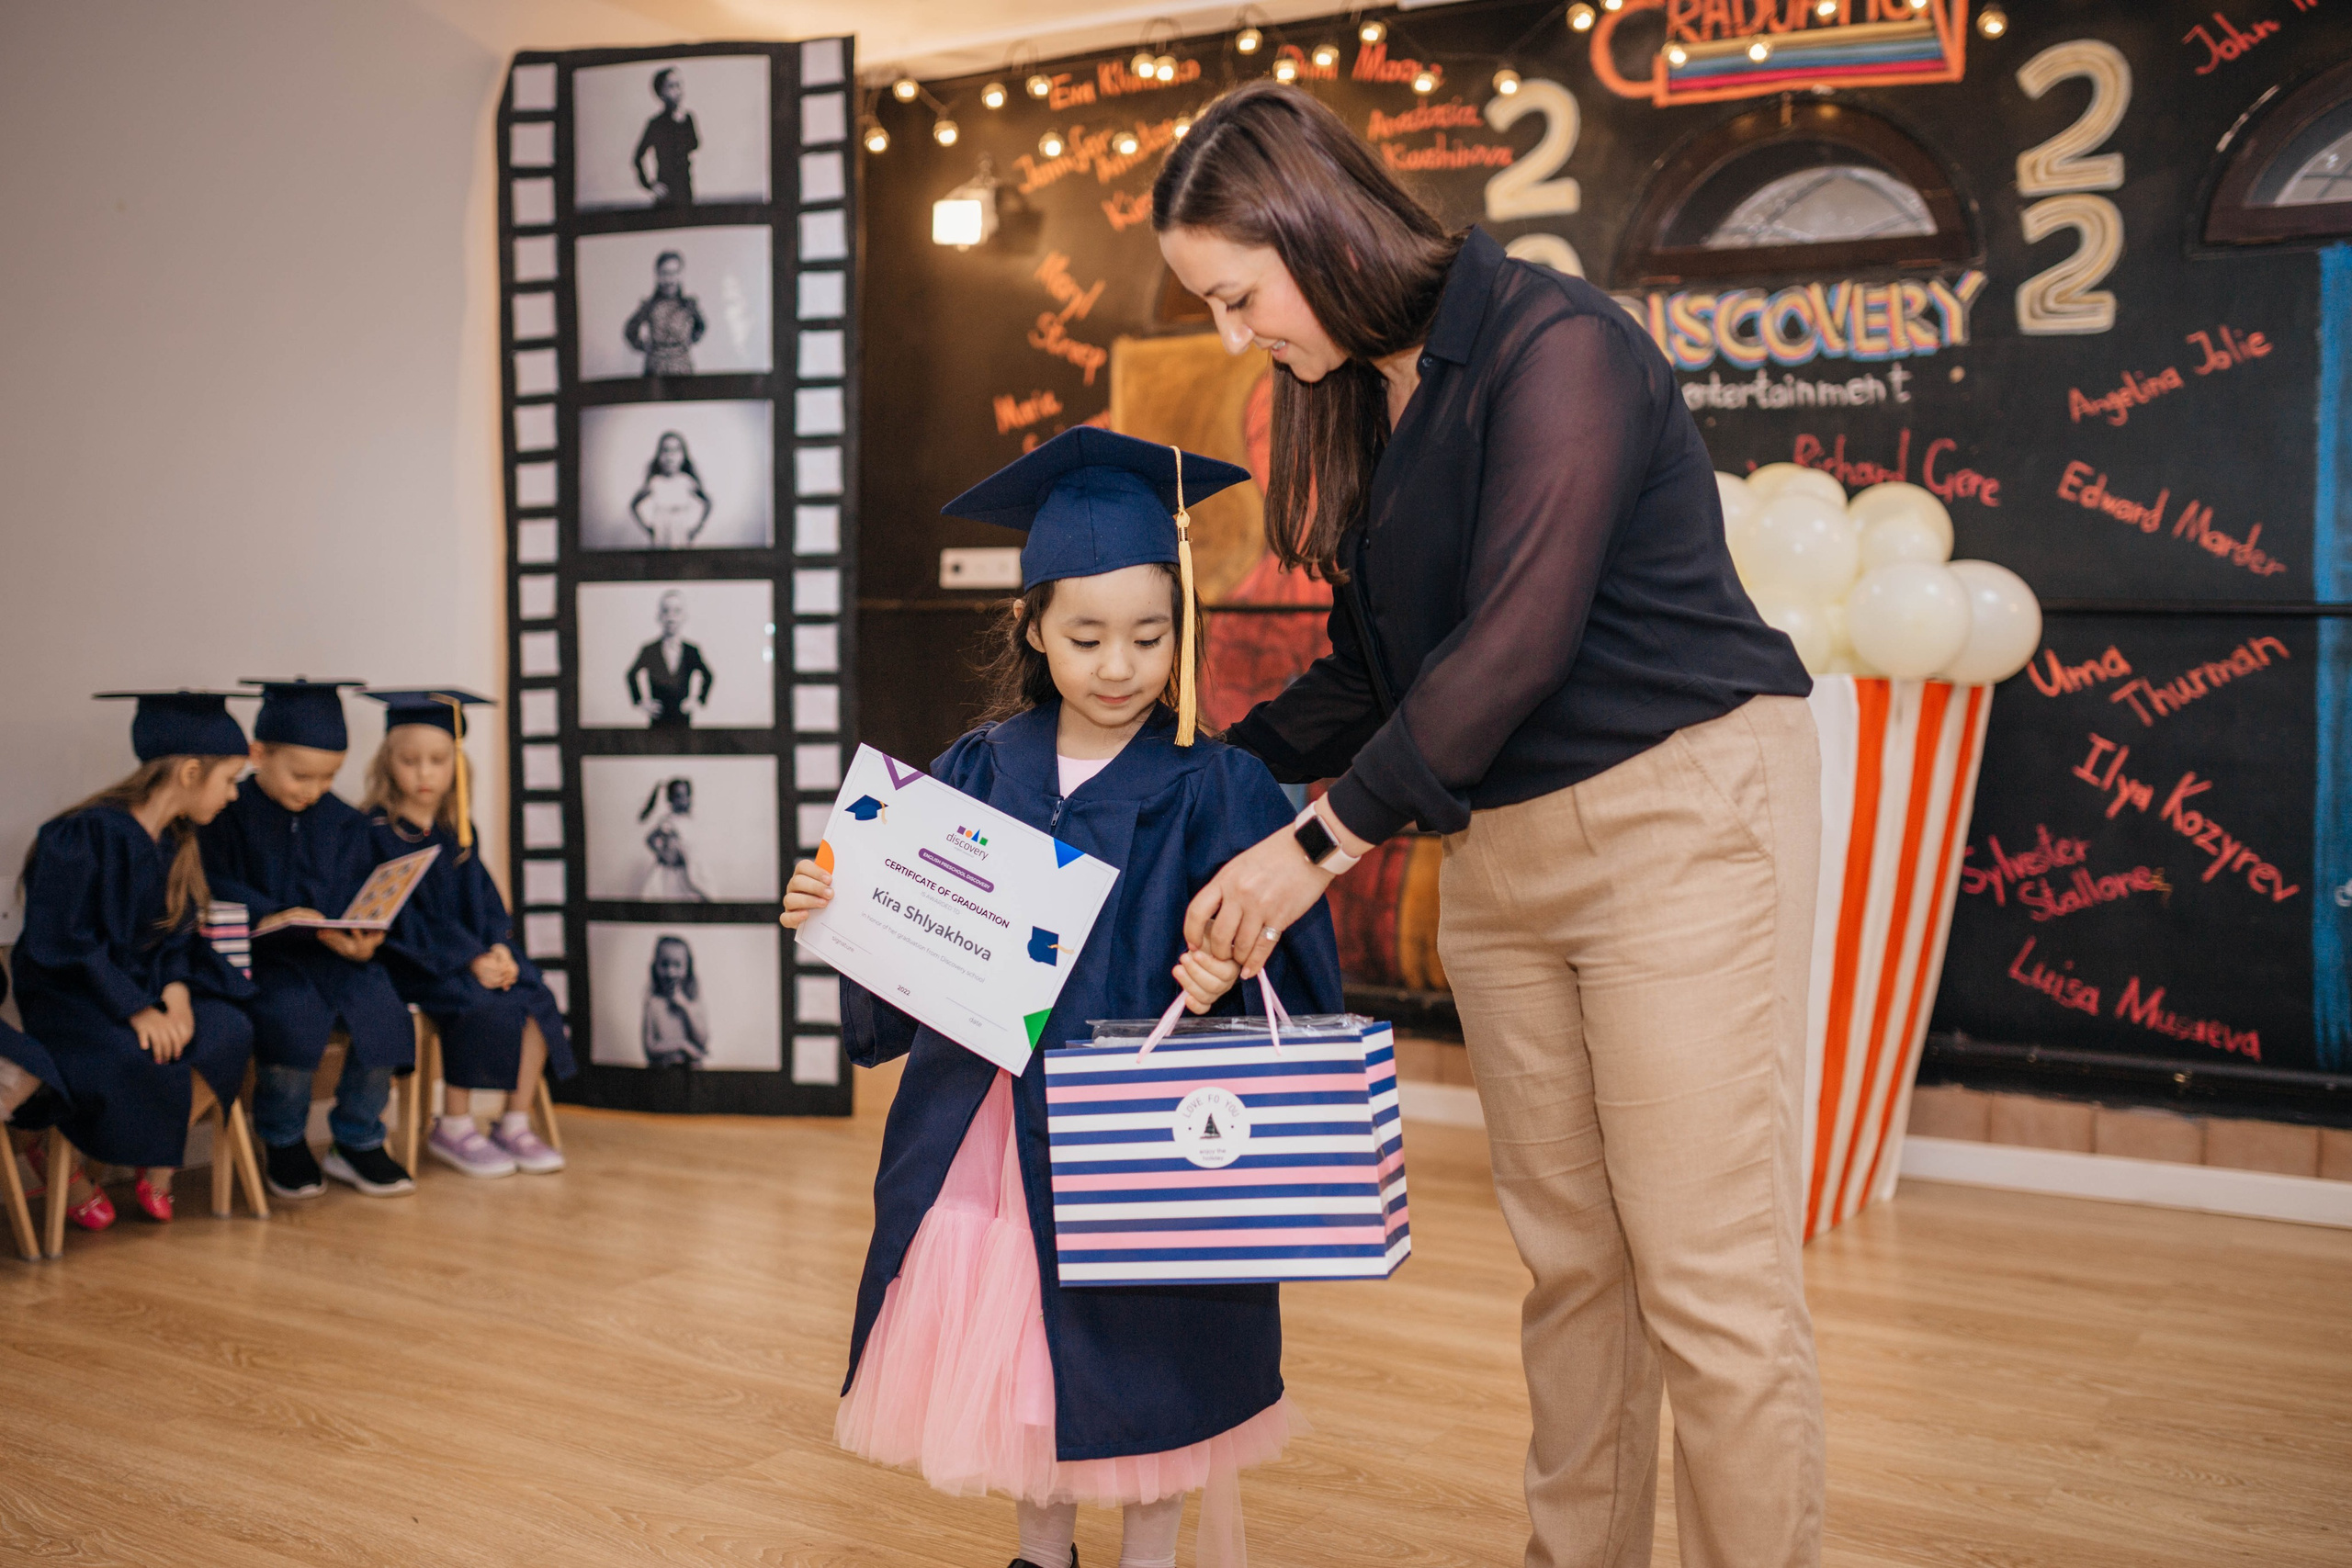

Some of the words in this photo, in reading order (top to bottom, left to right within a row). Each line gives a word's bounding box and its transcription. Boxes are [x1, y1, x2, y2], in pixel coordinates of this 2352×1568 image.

[2181, 11, 2281, 75] John
[1483, 79, 1581, 221] 2
[2015, 39, 2133, 197] 2
[2015, 193, 2125, 335] 2
[2068, 365, 2185, 426] Angelina
[2186, 323, 2274, 376] Jolie
[1922, 438, 2000, 507] Gere
[2056, 459, 2170, 534] Edward
[2026, 644, 2132, 698] Uma
[2109, 636, 2290, 727] Thurman
[945, 833, 989, 861] discovery
[2072, 732, 2154, 820] Ilya
[2161, 772, 2300, 903] Kozyrev
[885, 858, 937, 891] CERTIFICATE
[937, 886, 951, 897] OF
[951, 894, 1010, 929] GRADUATION
[922, 852, 941, 864] ENGLISH
[941, 861, 966, 877] PRESCHOOL
[966, 874, 991, 889] DISCOVERY
[925, 894, 953, 911] AWARDED
[2018, 865, 2156, 921] Stallone
[831, 935, 854, 953] signature
[872, 887, 901, 913] Kira
[904, 906, 991, 961] Shlyakhova
[888, 926, 898, 935] her
[897, 932, 926, 951] graduation
[926, 948, 940, 959] from
[940, 955, 966, 974] Discovery
[966, 970, 986, 984] school
[897, 985, 911, 997] 2022
[2007, 934, 2101, 1017] Luisa
[968, 1017, 983, 1028] date
[1182, 1097, 1204, 1118] LOVE
[1225, 1100, 1240, 1118] YOU
